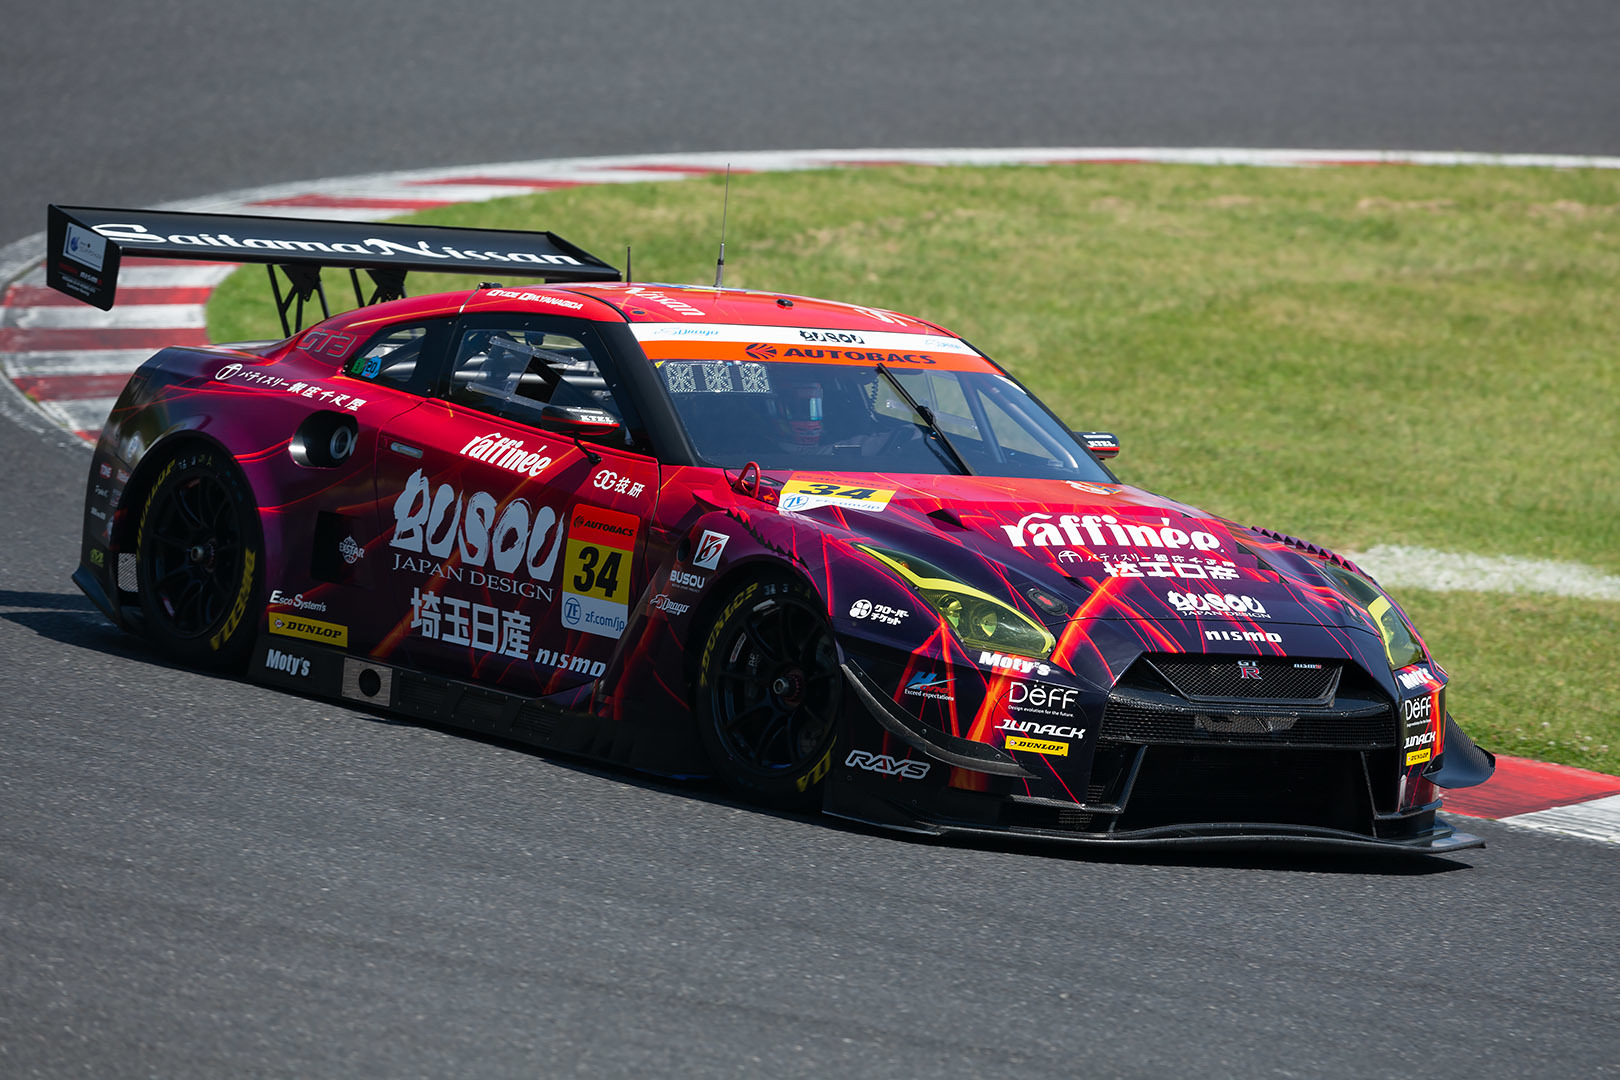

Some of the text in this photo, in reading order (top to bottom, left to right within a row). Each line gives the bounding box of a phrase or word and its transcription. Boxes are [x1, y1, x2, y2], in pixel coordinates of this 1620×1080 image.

[91, 224, 375, 255] Saitama
[363, 238, 584, 266] Nissan
[784, 347, 937, 364] AUTOBACS
[459, 431, 552, 478] raffinée
[798, 484, 877, 499] 34
[388, 467, 566, 582] BUSOU
[584, 519, 634, 537] AUTOBACS
[1000, 512, 1224, 553] raffinée
[392, 553, 553, 603] JAPAN DESIGN
[573, 545, 622, 599] 34
[670, 569, 705, 589] BUSOU
[1167, 590, 1266, 614] BUSOU
[286, 621, 342, 639] DUNLOP
[410, 587, 531, 661] 埼玉日産
[585, 610, 626, 633] zf.com/jp
[1204, 630, 1283, 643] nismo
[265, 648, 311, 676] Moty's
[535, 647, 607, 678] nismo
[978, 650, 1051, 676] Moty's
[904, 688, 955, 701] Exceed expectations
[1007, 704, 1023, 712] Design
[1024, 706, 1044, 714] evolution
[994, 719, 1086, 739] JUNACK
[1018, 741, 1064, 751] DUNLOP
[844, 749, 931, 780] RAYS
